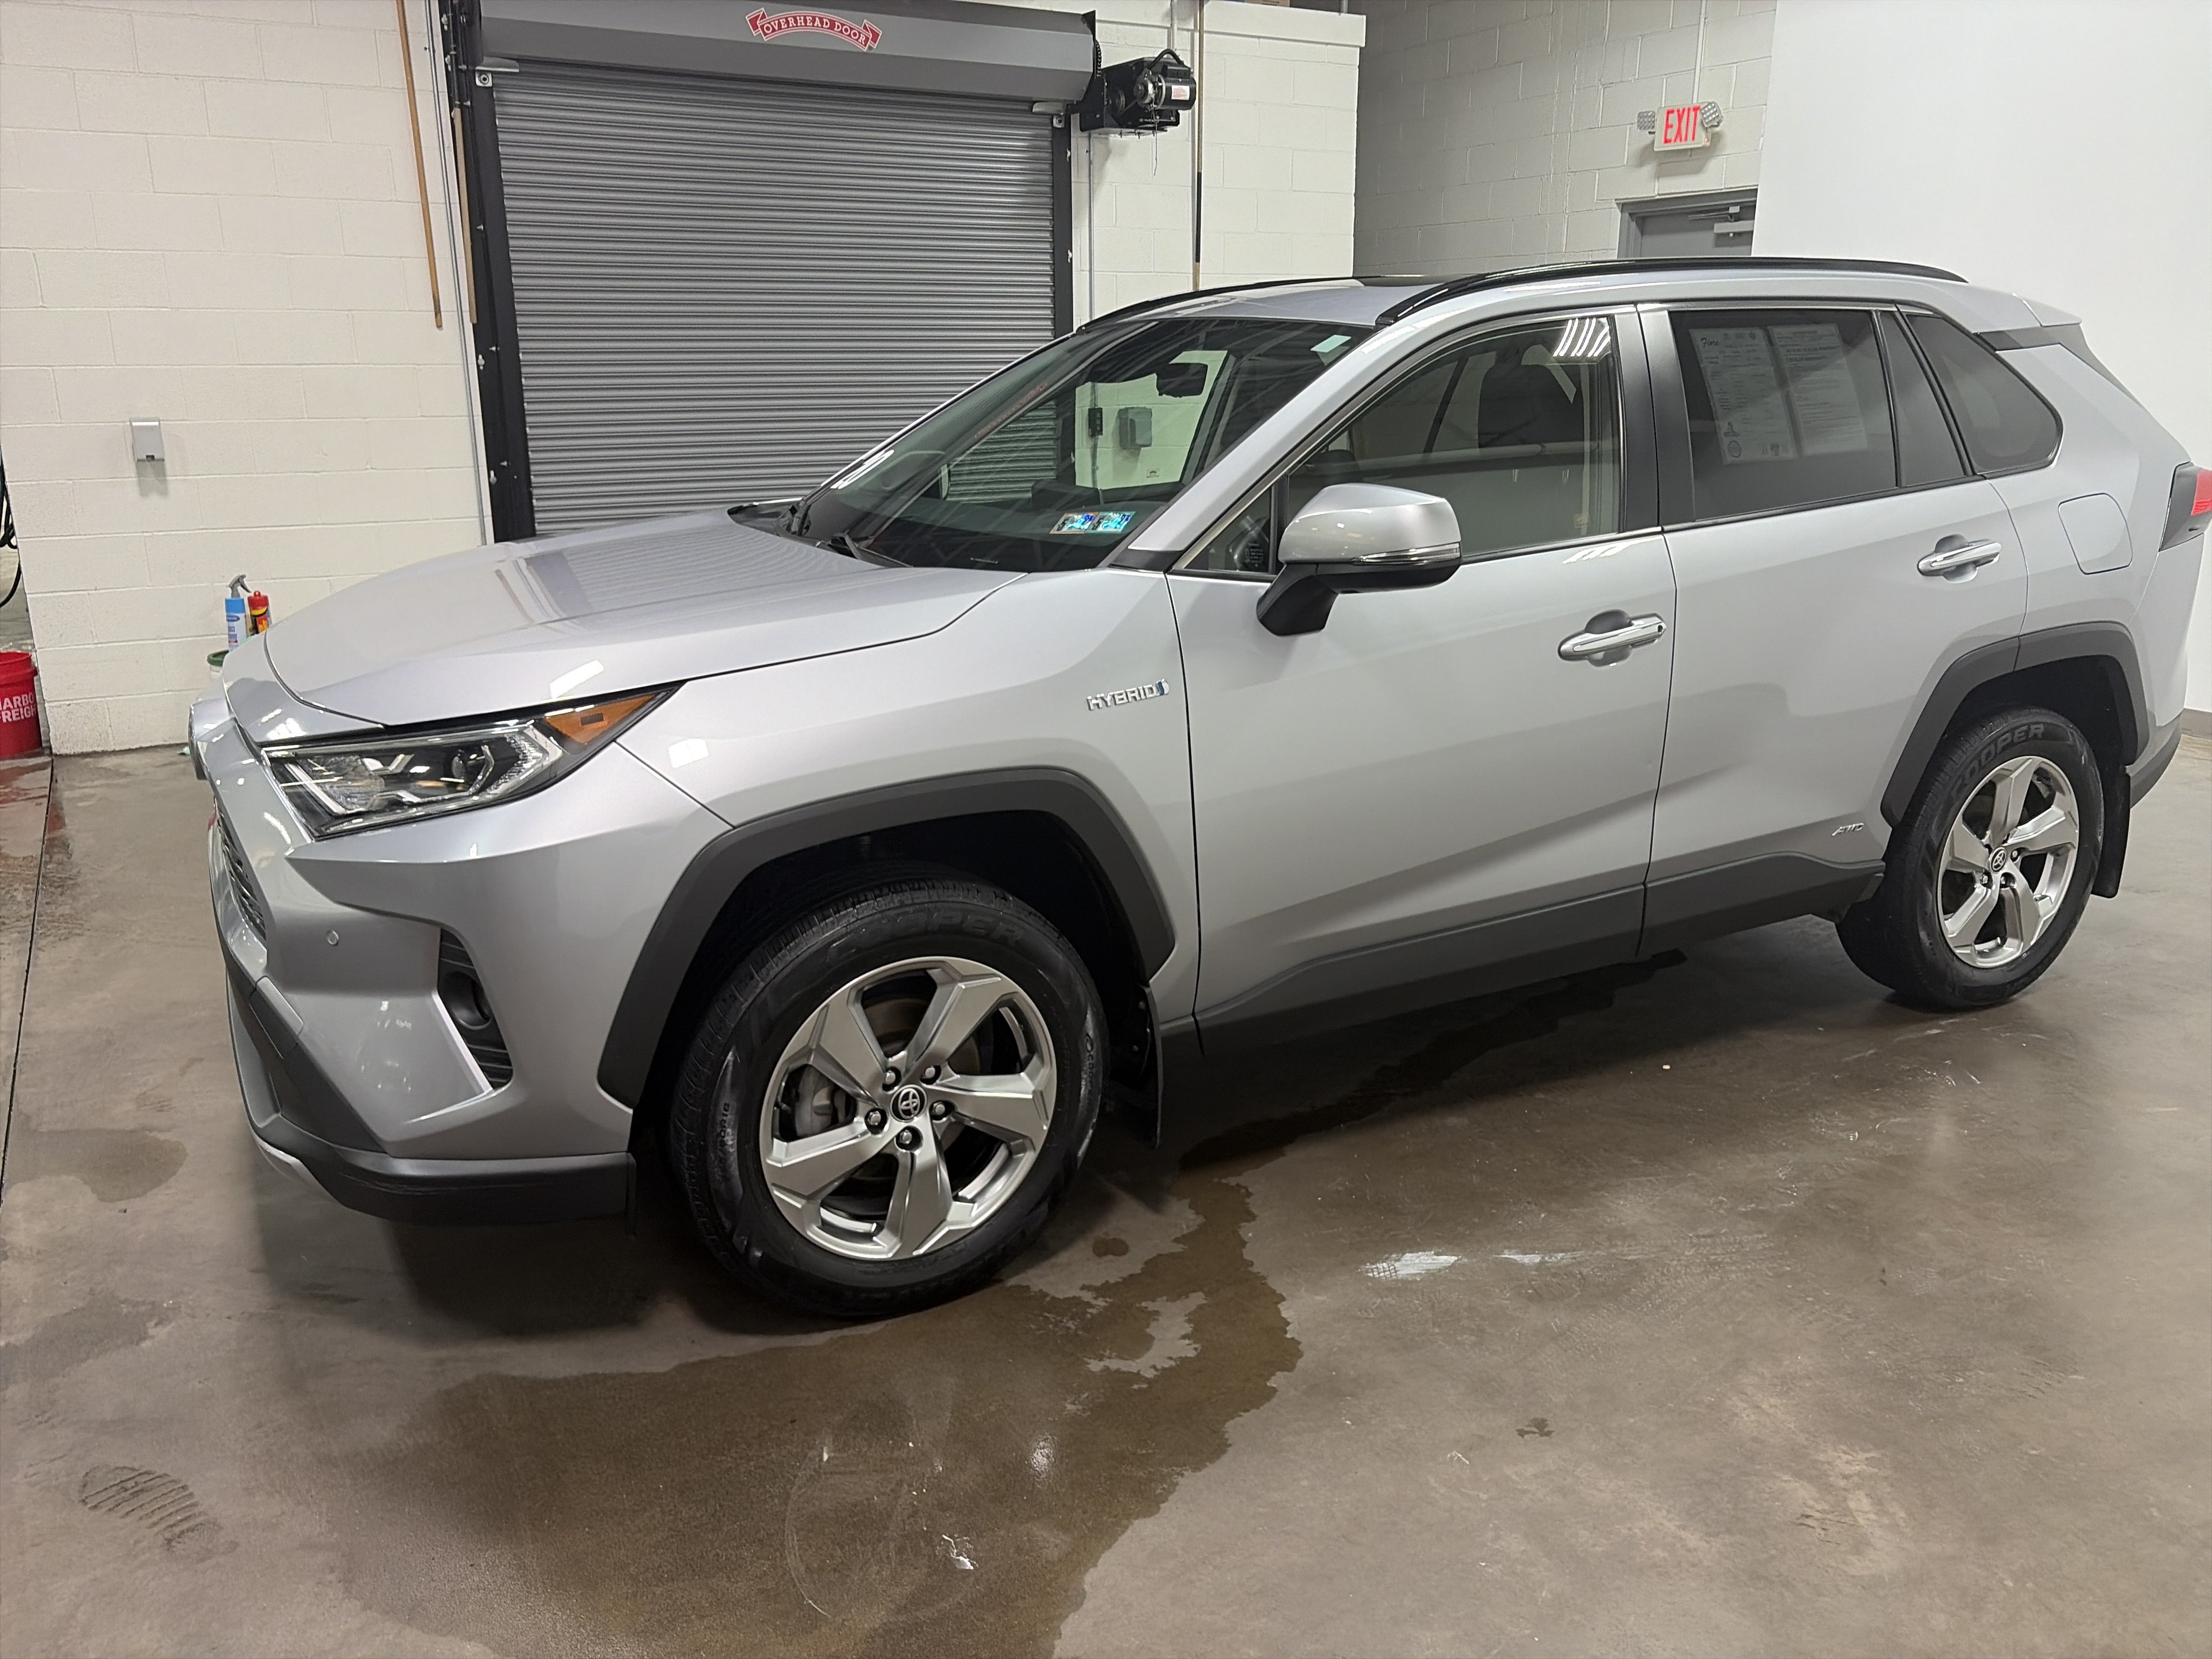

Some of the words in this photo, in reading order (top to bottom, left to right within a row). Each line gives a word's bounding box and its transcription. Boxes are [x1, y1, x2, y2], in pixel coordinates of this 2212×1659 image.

[763, 15, 830, 34] OVERHEAD
[833, 22, 867, 45] DOOR
[1663, 105, 1701, 144] EXIT
[1086, 684, 1156, 710] HYBRID
[0, 703, 37, 723] REIGH
